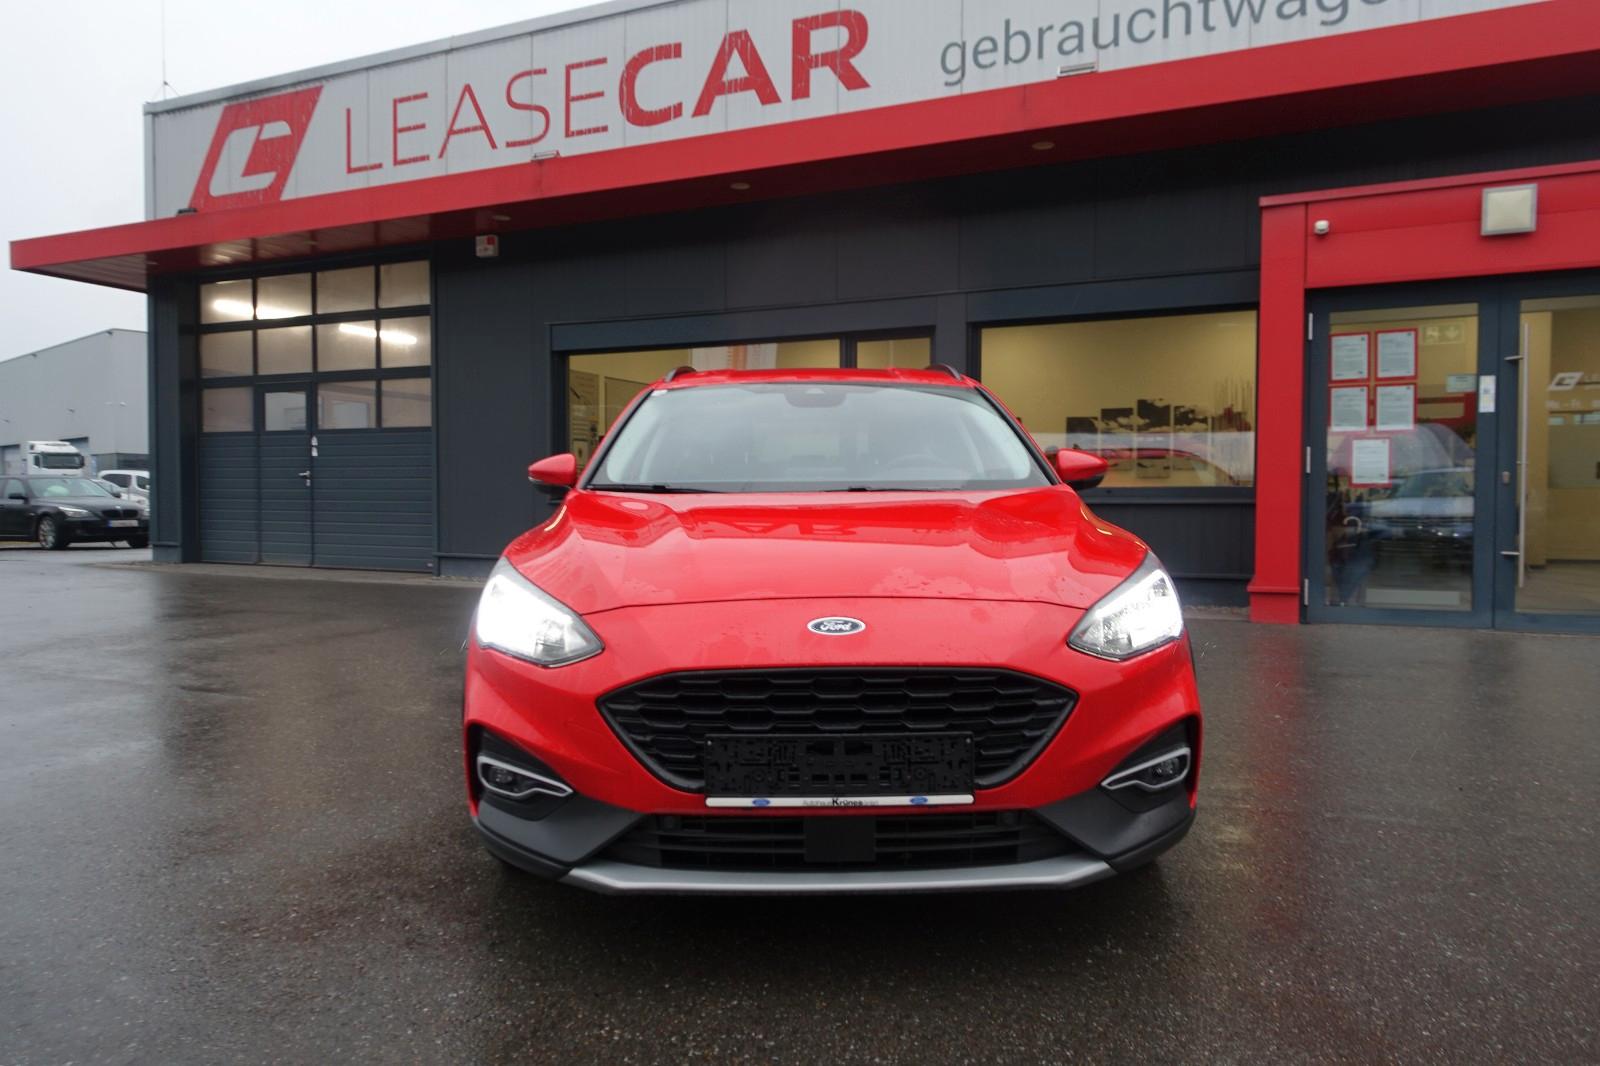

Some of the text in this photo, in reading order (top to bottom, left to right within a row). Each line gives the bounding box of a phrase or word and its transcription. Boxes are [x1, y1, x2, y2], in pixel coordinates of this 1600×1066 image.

[940, 0, 1386, 87] gebrauchtwag
[345, 9, 870, 174] LEASECAR
[819, 619, 853, 632] Ford
